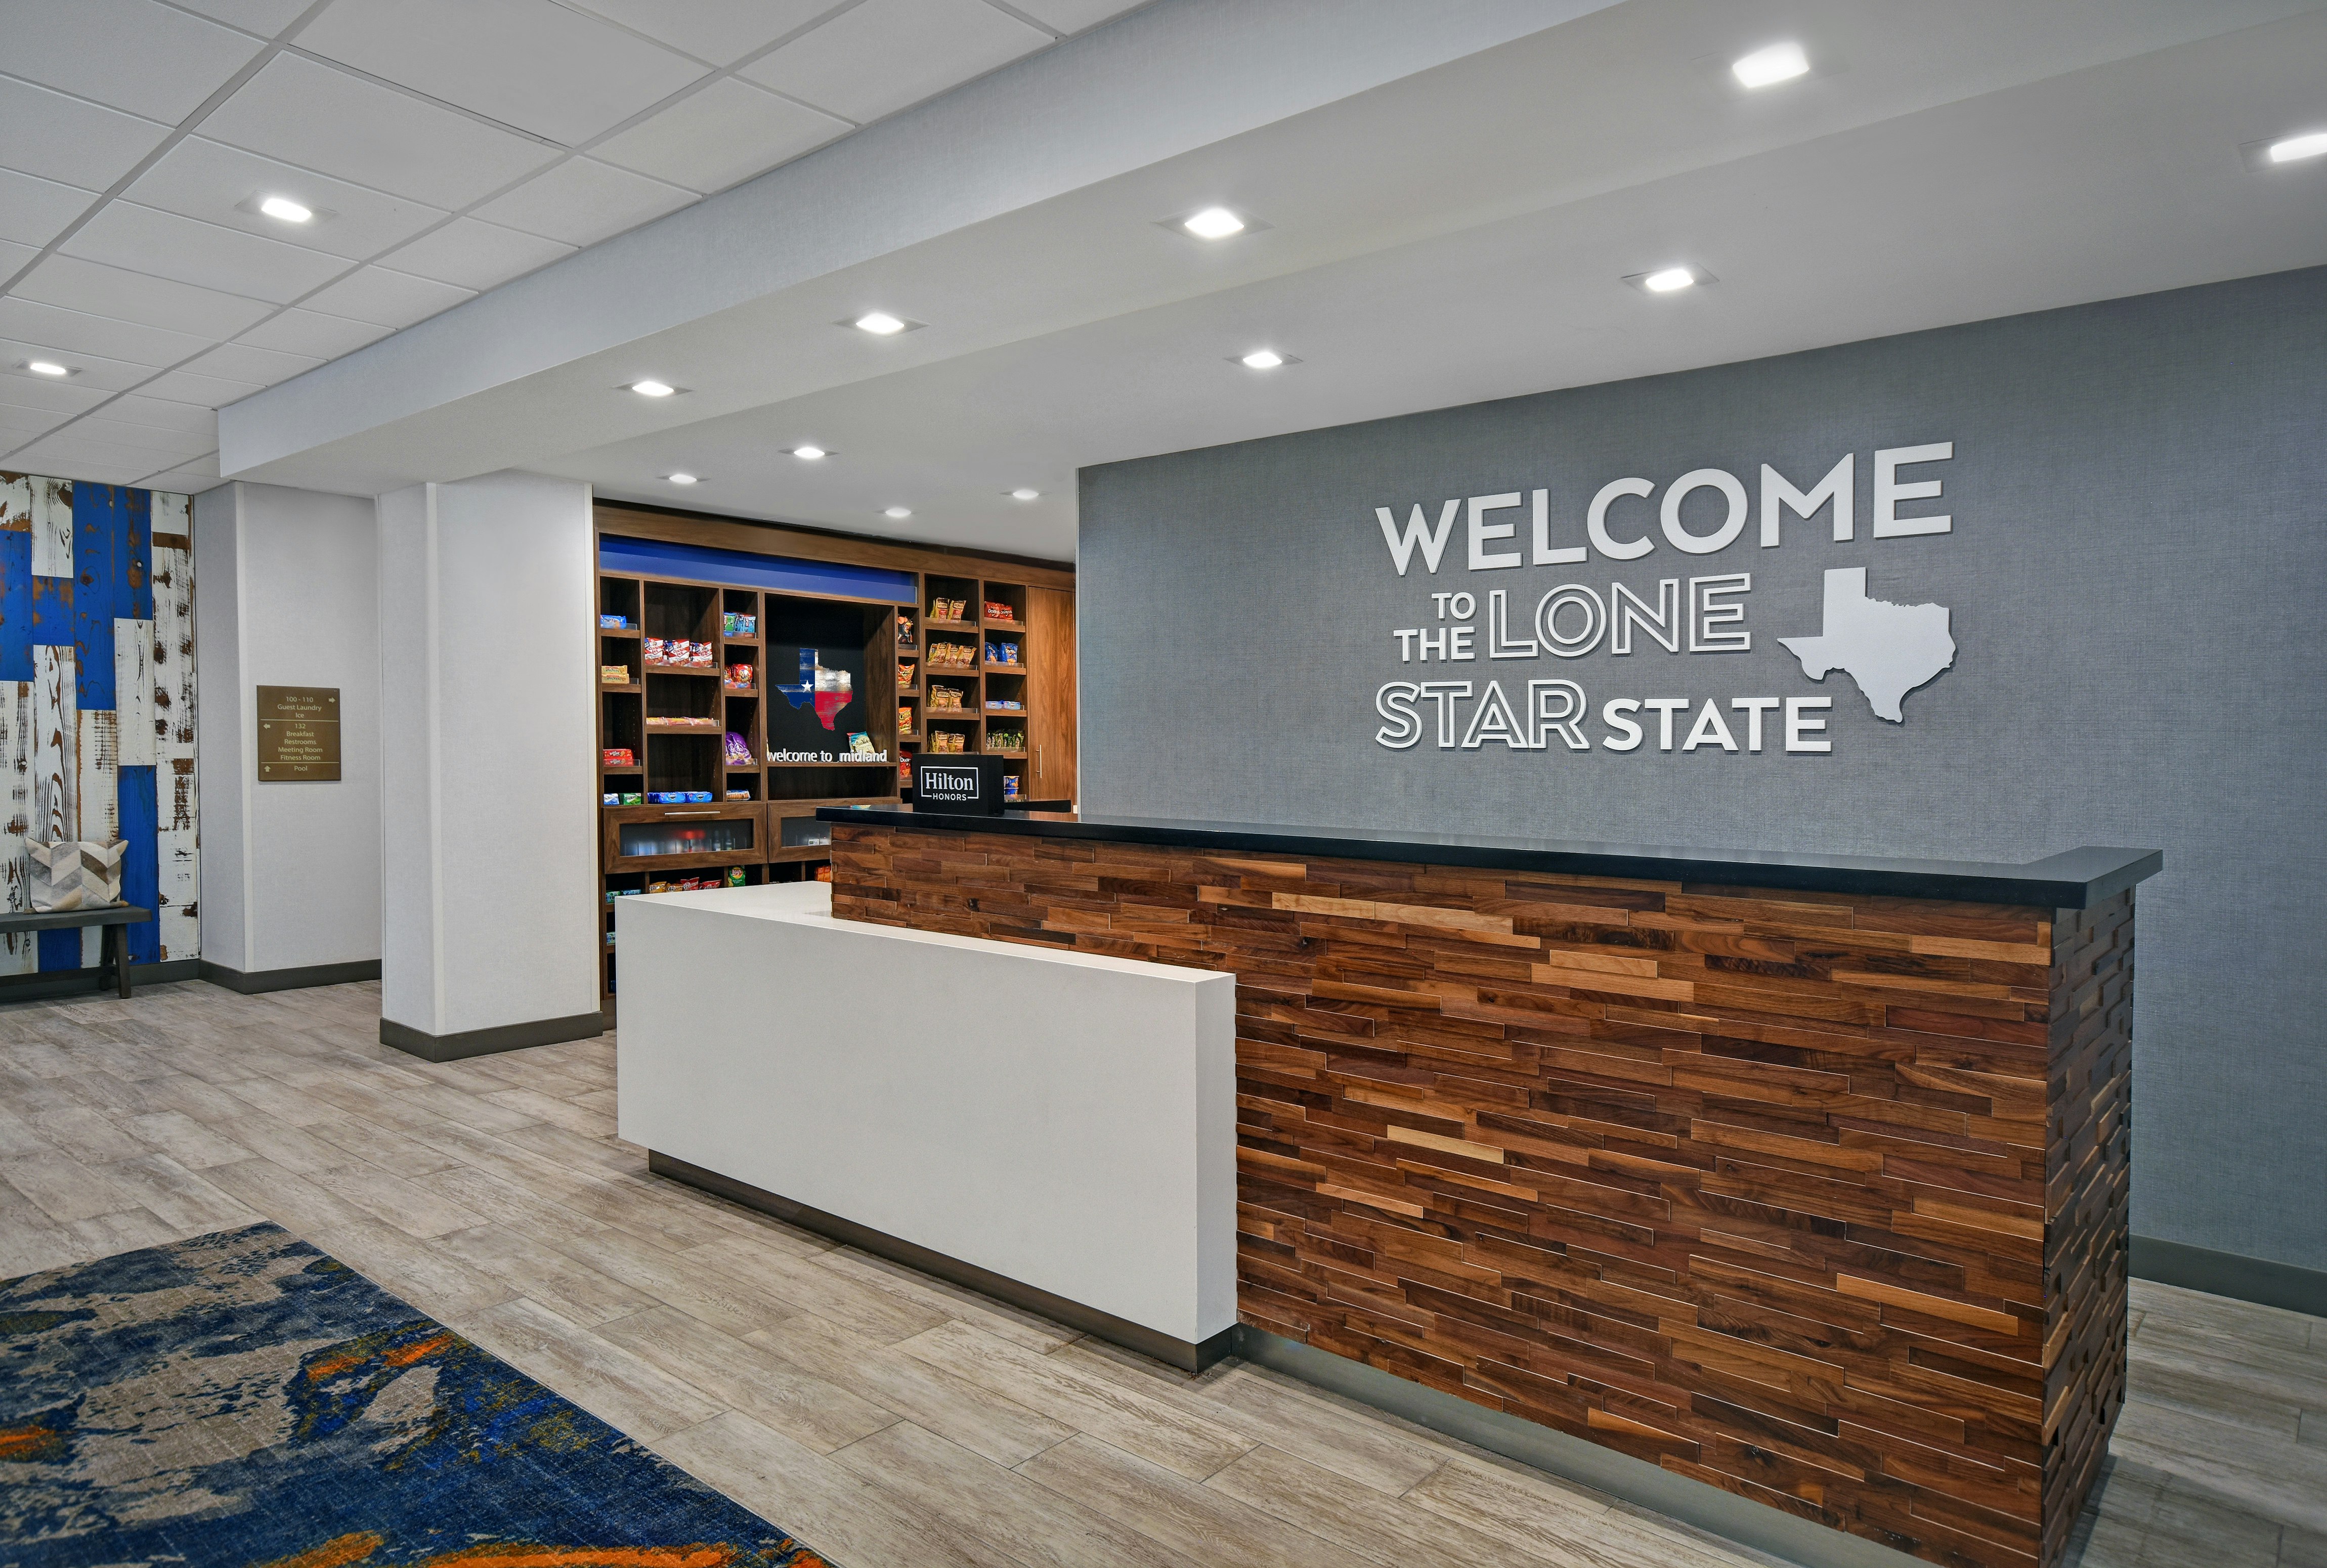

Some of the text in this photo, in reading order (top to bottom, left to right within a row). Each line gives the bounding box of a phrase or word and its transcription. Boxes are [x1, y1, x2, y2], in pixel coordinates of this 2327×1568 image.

[1375, 442, 1954, 576] WELCOME
[1432, 592, 1476, 620] TO
[1488, 573, 1752, 659] LONE
[1393, 626, 1475, 662] THE
[1375, 679, 1832, 752] STAR STATE
[766, 748, 887, 762] welcome to midland
[925, 772, 974, 791] Hilton
[932, 793, 967, 801] HONORS
